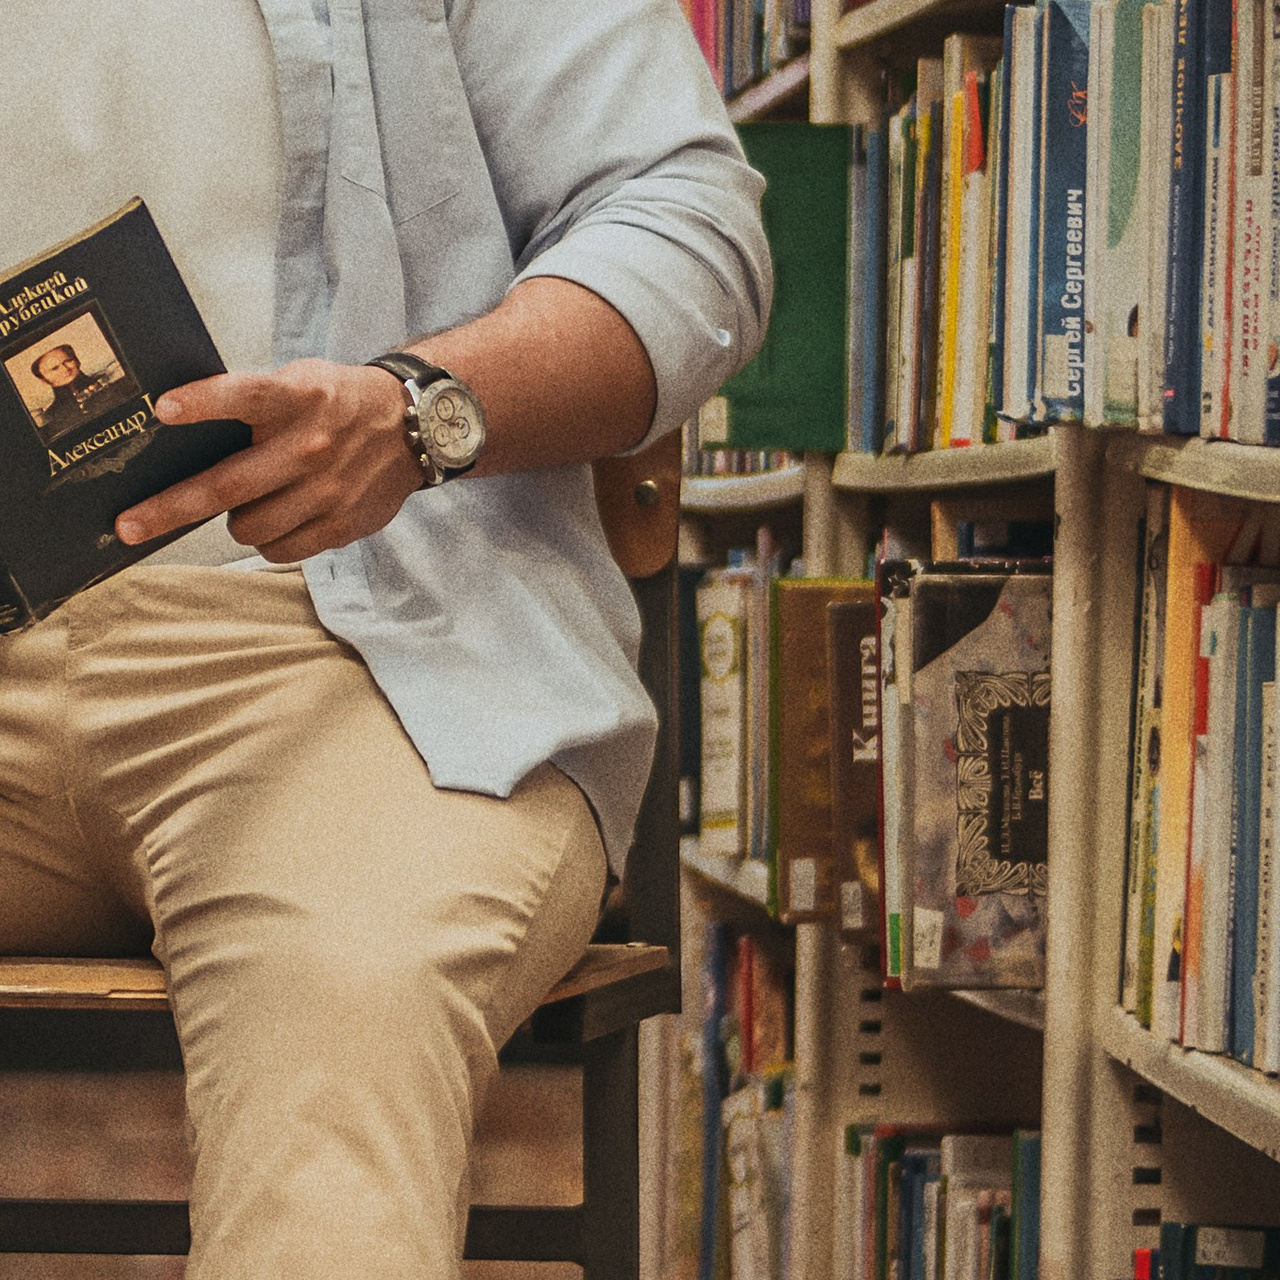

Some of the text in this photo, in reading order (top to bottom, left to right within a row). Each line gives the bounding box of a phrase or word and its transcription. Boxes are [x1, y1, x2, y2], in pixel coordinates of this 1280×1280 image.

[1173, 57, 1187, 171] ЗАОЧНОЕ
[1061, 188, 1084, 309] Сергеевич
[46, 392, 158, 477] Александр I
[852, 635, 878, 764] Книга
[1028, 770, 1044, 801] Всё
